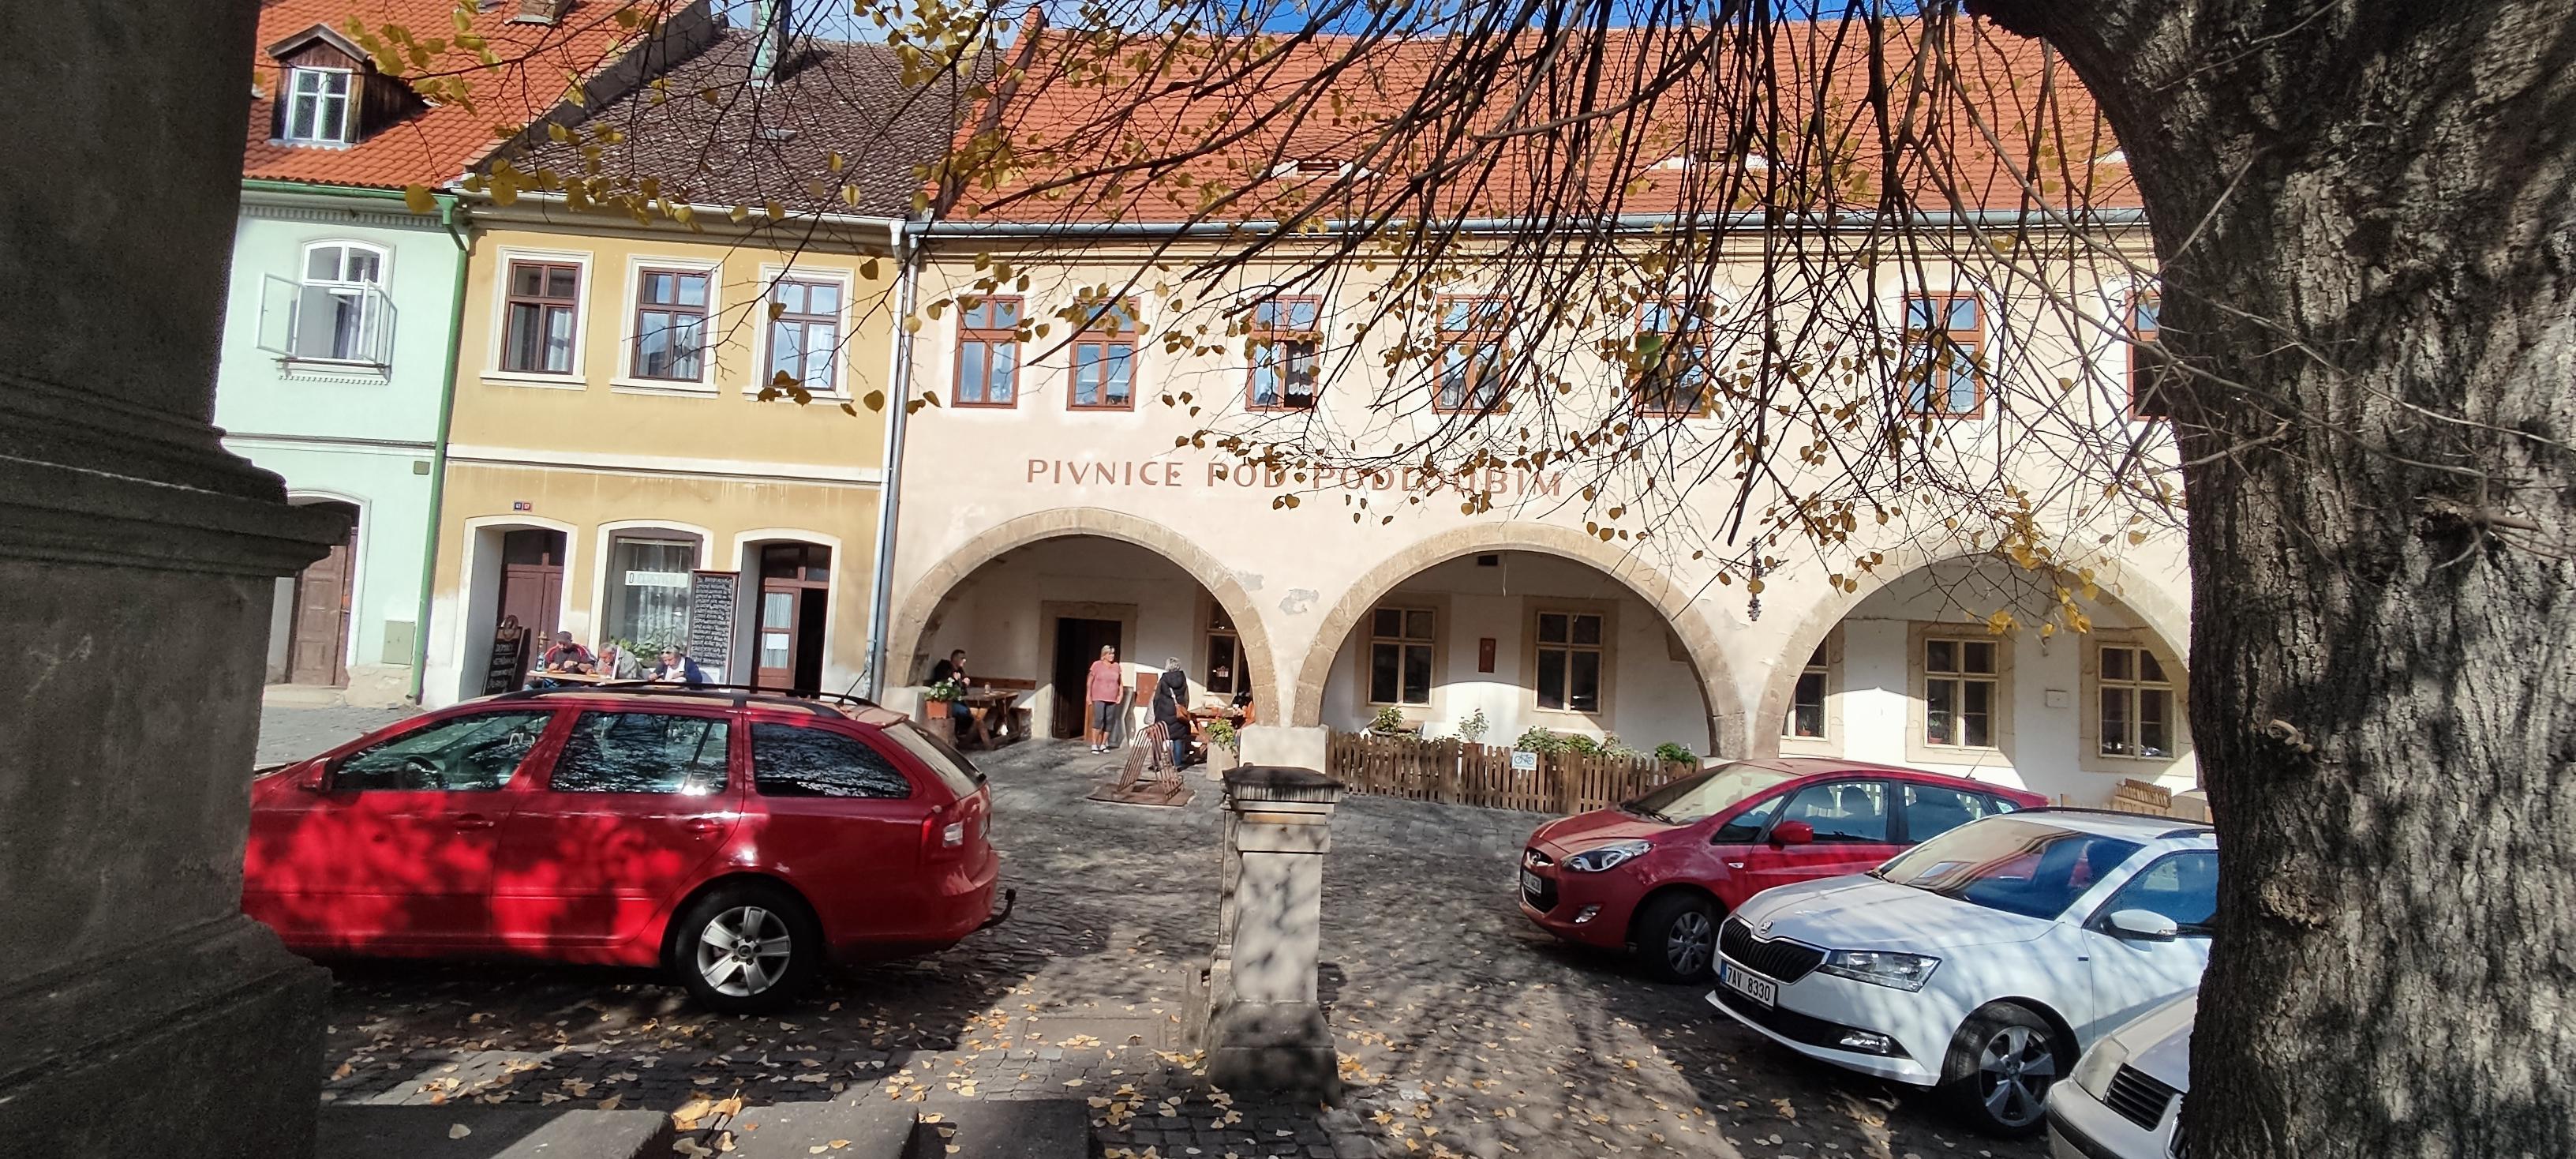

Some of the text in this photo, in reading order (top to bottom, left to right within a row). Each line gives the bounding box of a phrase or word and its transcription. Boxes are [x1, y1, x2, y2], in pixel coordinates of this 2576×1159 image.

[1028, 459, 1184, 487] PIVNICE
[1208, 462, 1286, 488] POD
[1727, 966, 1771, 1002] 7AV 8330
